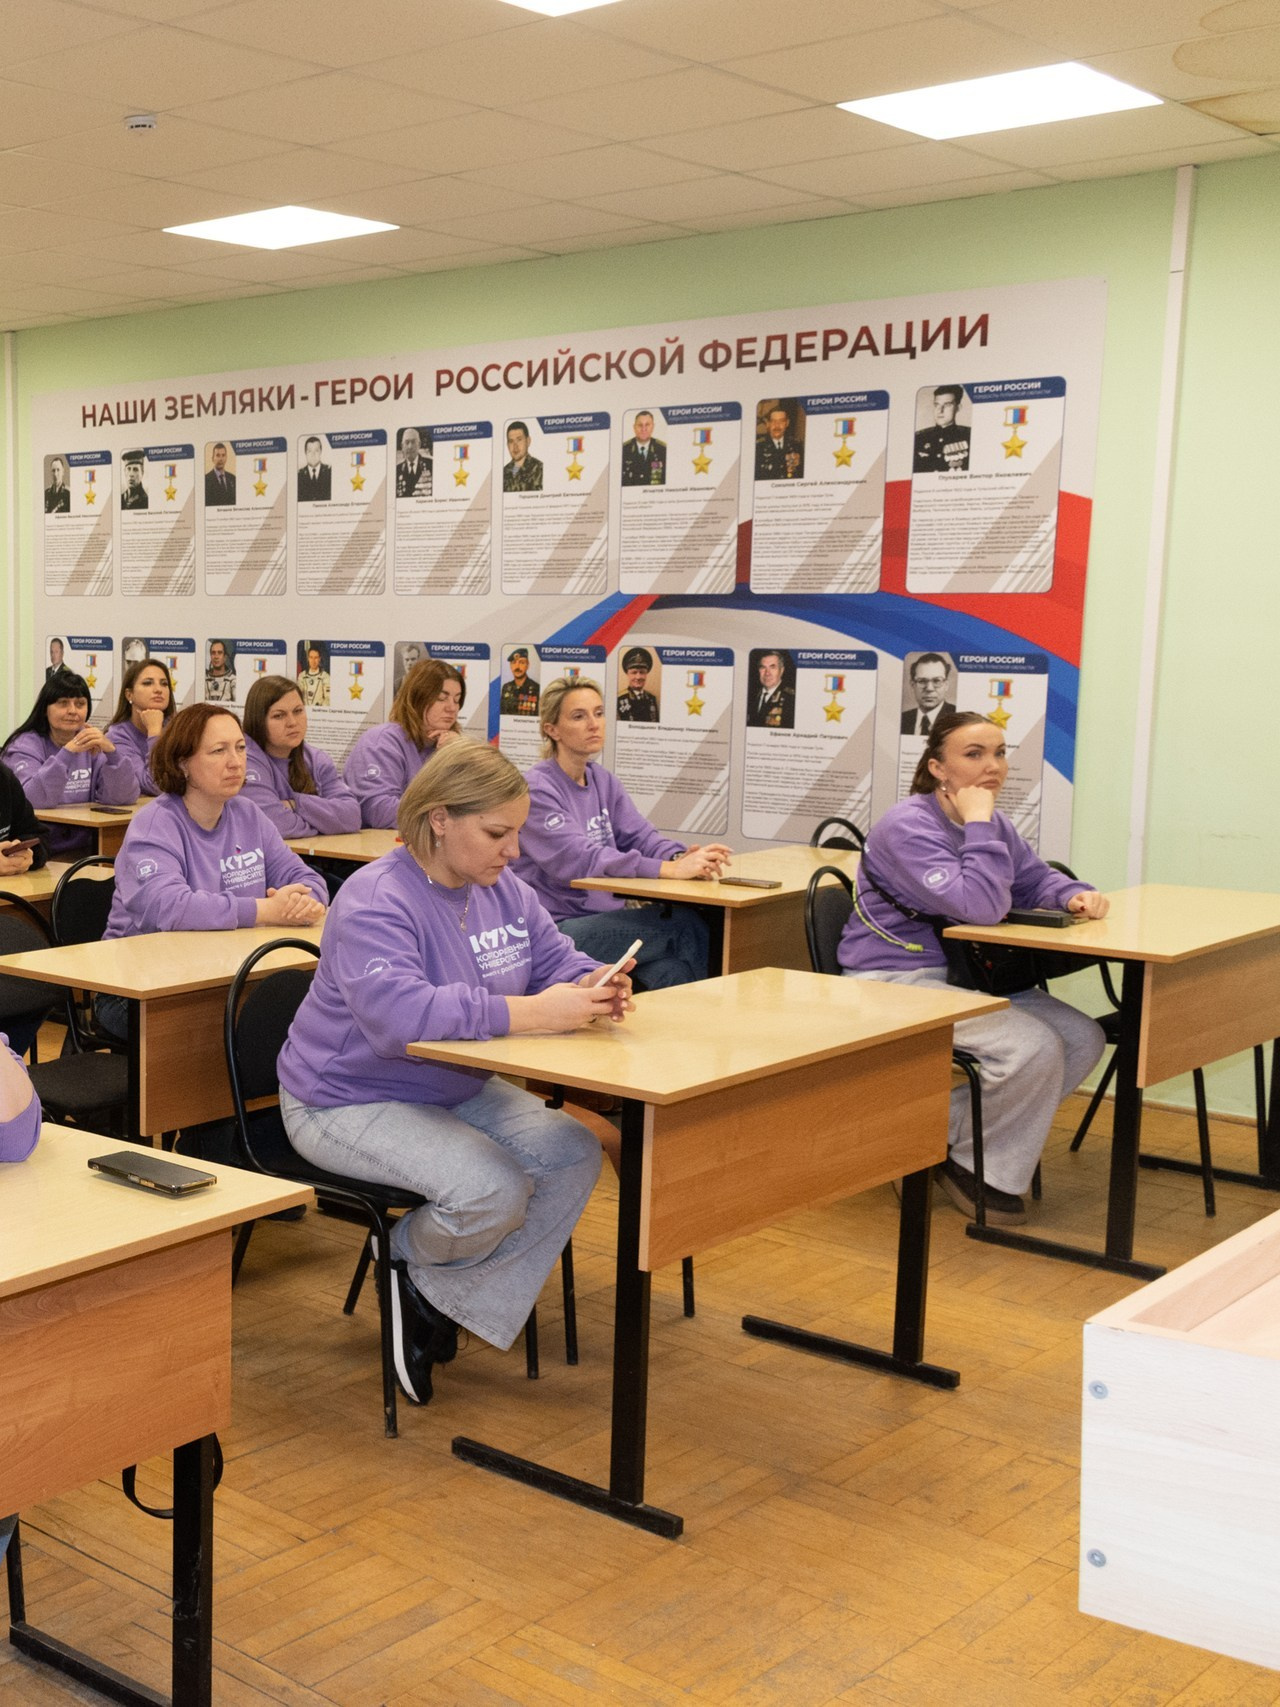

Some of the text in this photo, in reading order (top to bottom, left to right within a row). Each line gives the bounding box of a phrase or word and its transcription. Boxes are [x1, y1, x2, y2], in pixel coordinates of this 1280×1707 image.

[81, 398, 157, 429] НАШИ
[435, 336, 685, 397] РОССИЙСКОЙ
[697, 313, 990, 373] ФЕДЕРАЦИИ
[973, 382, 1041, 393] ГЕРОИ РОССИИ
[807, 395, 867, 406] ГЕРОИ РОССИИ
[668, 406, 722, 416] ГЕРОИ РОССИИ
[544, 416, 593, 426] ГЕРОИ РОССИИ
[563, 647, 590, 655] РОССИИ
[662, 649, 685, 657] ГЕРОИ
[798, 652, 857, 660] ГЕРОИ РОССИИ
[959, 655, 1026, 664] ГЕРОИ РОССИИ
